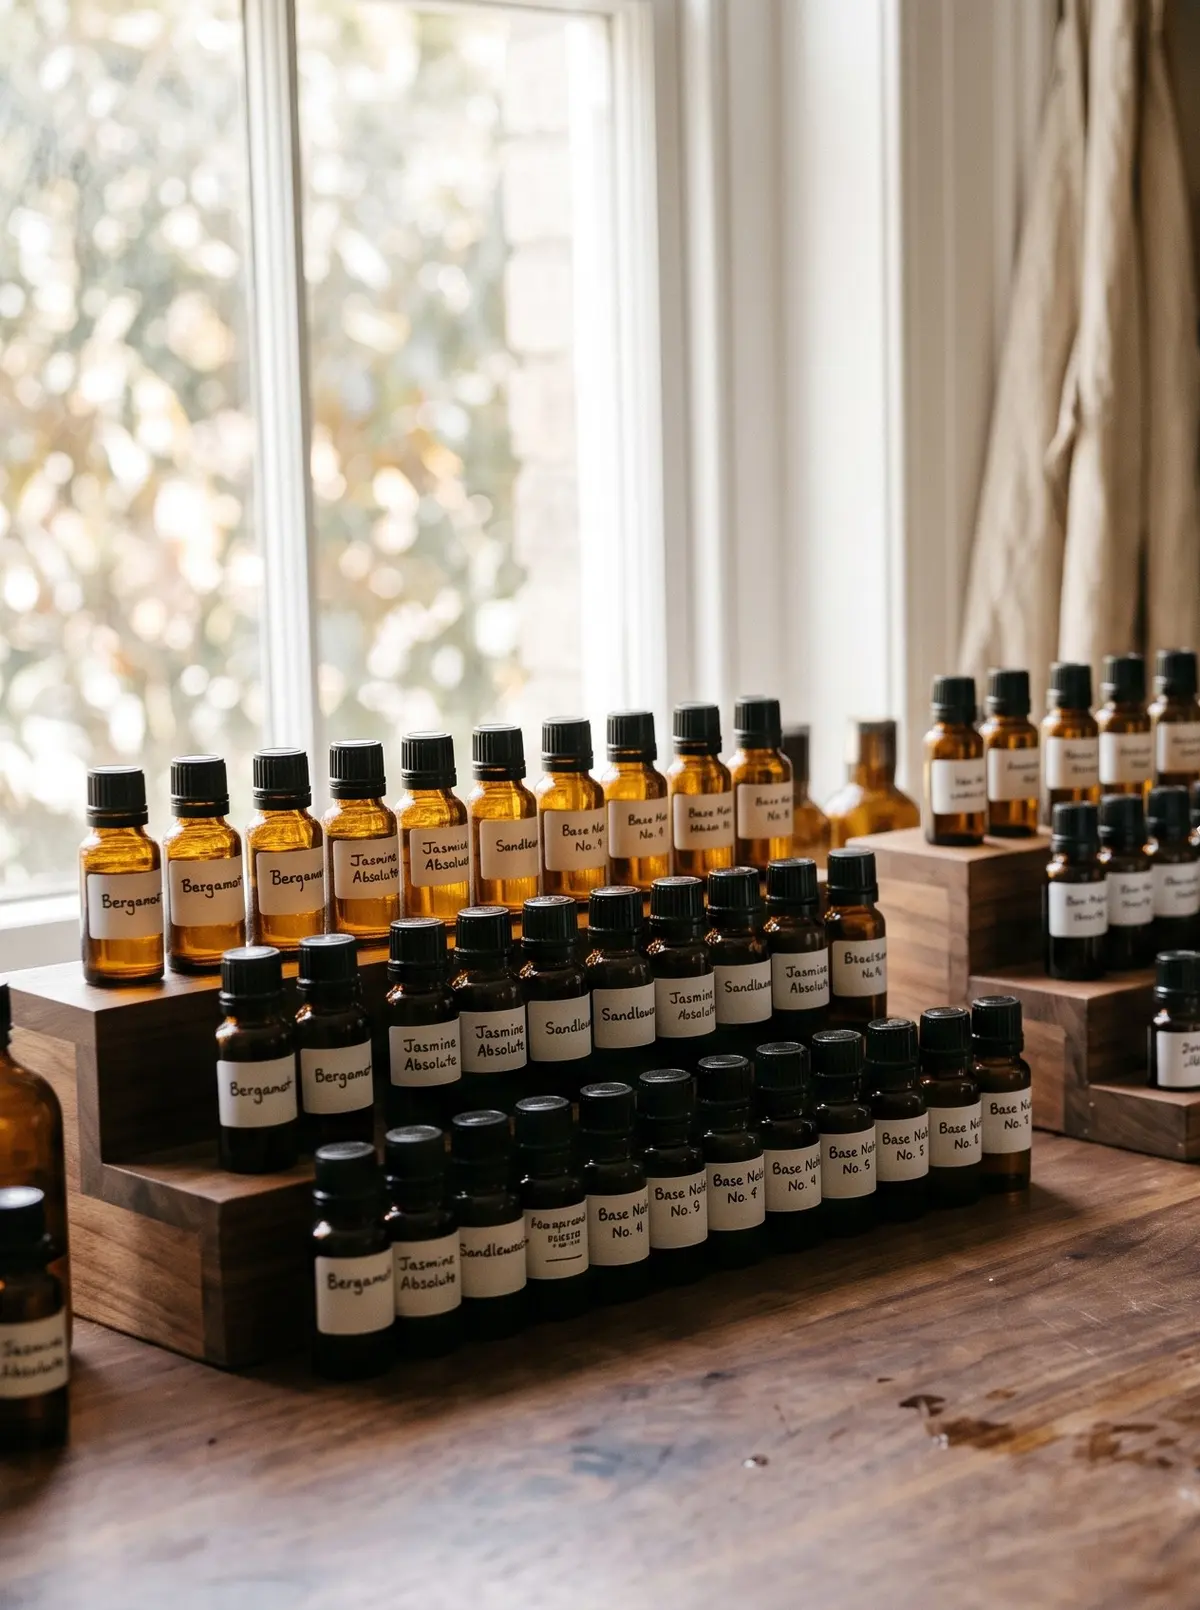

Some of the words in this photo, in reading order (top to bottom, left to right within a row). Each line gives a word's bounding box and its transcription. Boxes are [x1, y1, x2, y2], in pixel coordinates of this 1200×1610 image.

[562, 824, 589, 837] Base
[575, 840, 596, 852] No.
[475, 1023, 524, 1039] Jasmine
[403, 1037, 457, 1053] Jasmine
[477, 1039, 525, 1058] Absolute
[404, 1054, 457, 1071] Absolute
[990, 1102, 1018, 1116] Base
[939, 1122, 967, 1135] Base
[1004, 1118, 1022, 1130] No.
[882, 1132, 910, 1146] Base
[954, 1138, 972, 1150] No.
[829, 1146, 858, 1160] Base
[896, 1149, 916, 1161] No.
[919, 1145, 925, 1157] 5
[772, 1161, 802, 1175] Base
[842, 1163, 862, 1175] No.
[864, 1159, 871, 1171] 5
[713, 1173, 744, 1187] Base
[788, 1180, 808, 1192] No.
[655, 1187, 686, 1201] Base
[727, 1191, 748, 1204] No.
[598, 1207, 630, 1222] Base
[671, 1203, 692, 1217] No.
[612, 1225, 632, 1239] No.
